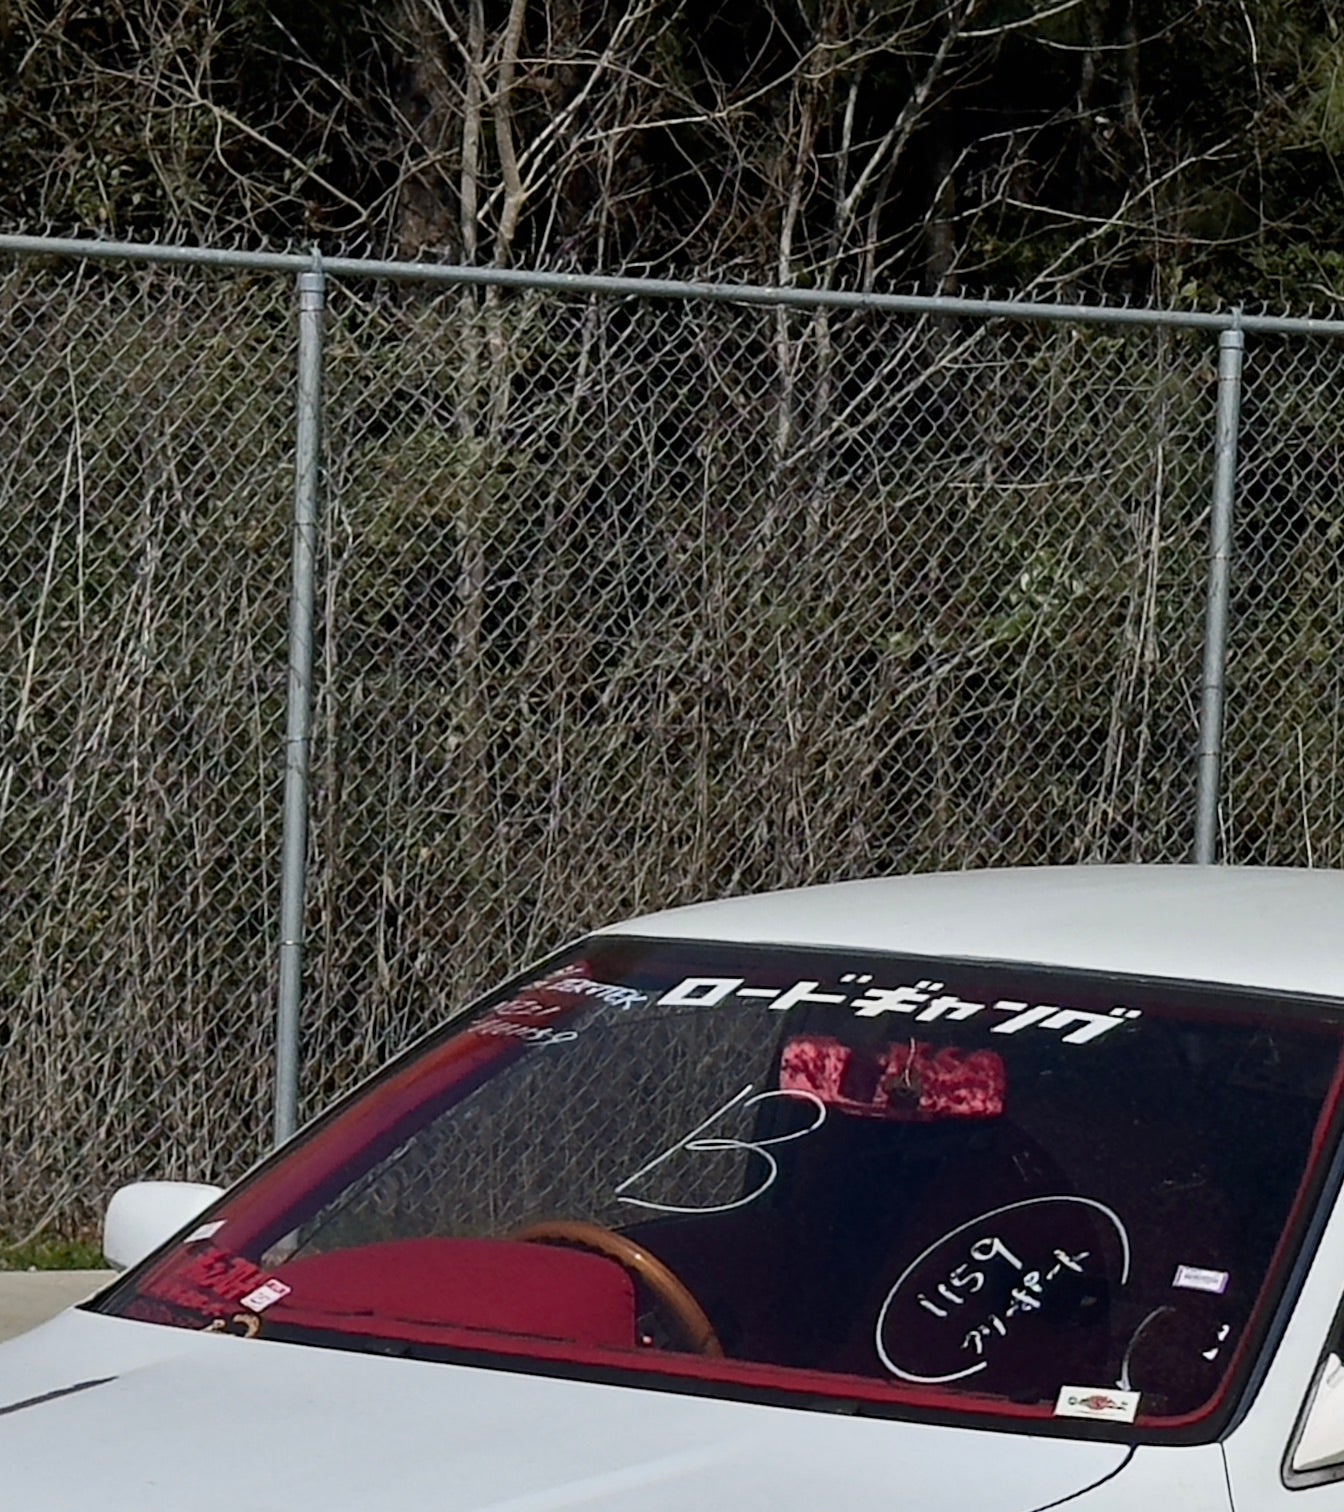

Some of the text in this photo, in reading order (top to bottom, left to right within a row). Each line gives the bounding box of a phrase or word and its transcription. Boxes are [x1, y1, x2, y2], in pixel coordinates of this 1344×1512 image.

[656, 973, 1142, 1045] ロードギャング
[614, 1083, 827, 1214] B
[916, 1237, 1024, 1318] 1159
